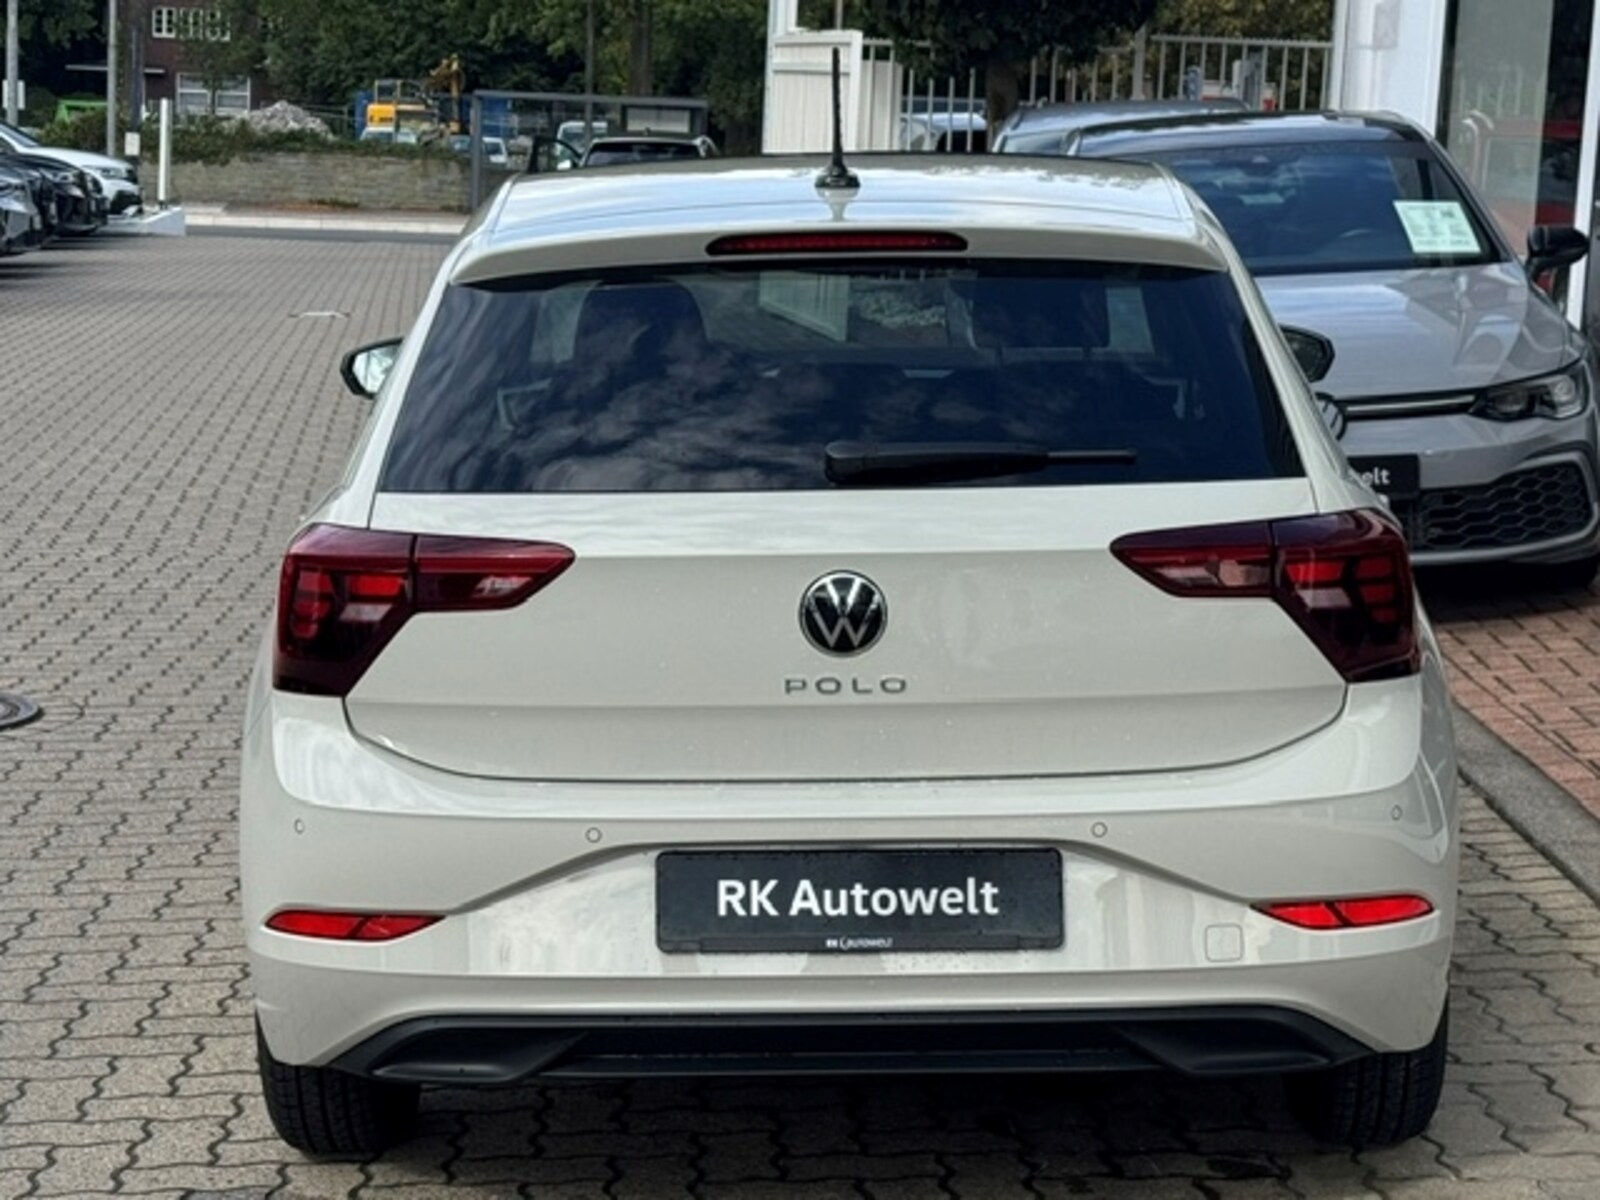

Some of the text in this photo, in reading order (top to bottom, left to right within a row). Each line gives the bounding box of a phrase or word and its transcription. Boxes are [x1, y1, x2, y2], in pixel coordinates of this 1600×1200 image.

[1361, 467, 1391, 486] elt
[784, 677, 906, 695] POLO
[717, 877, 1000, 917] RK Autowelt
